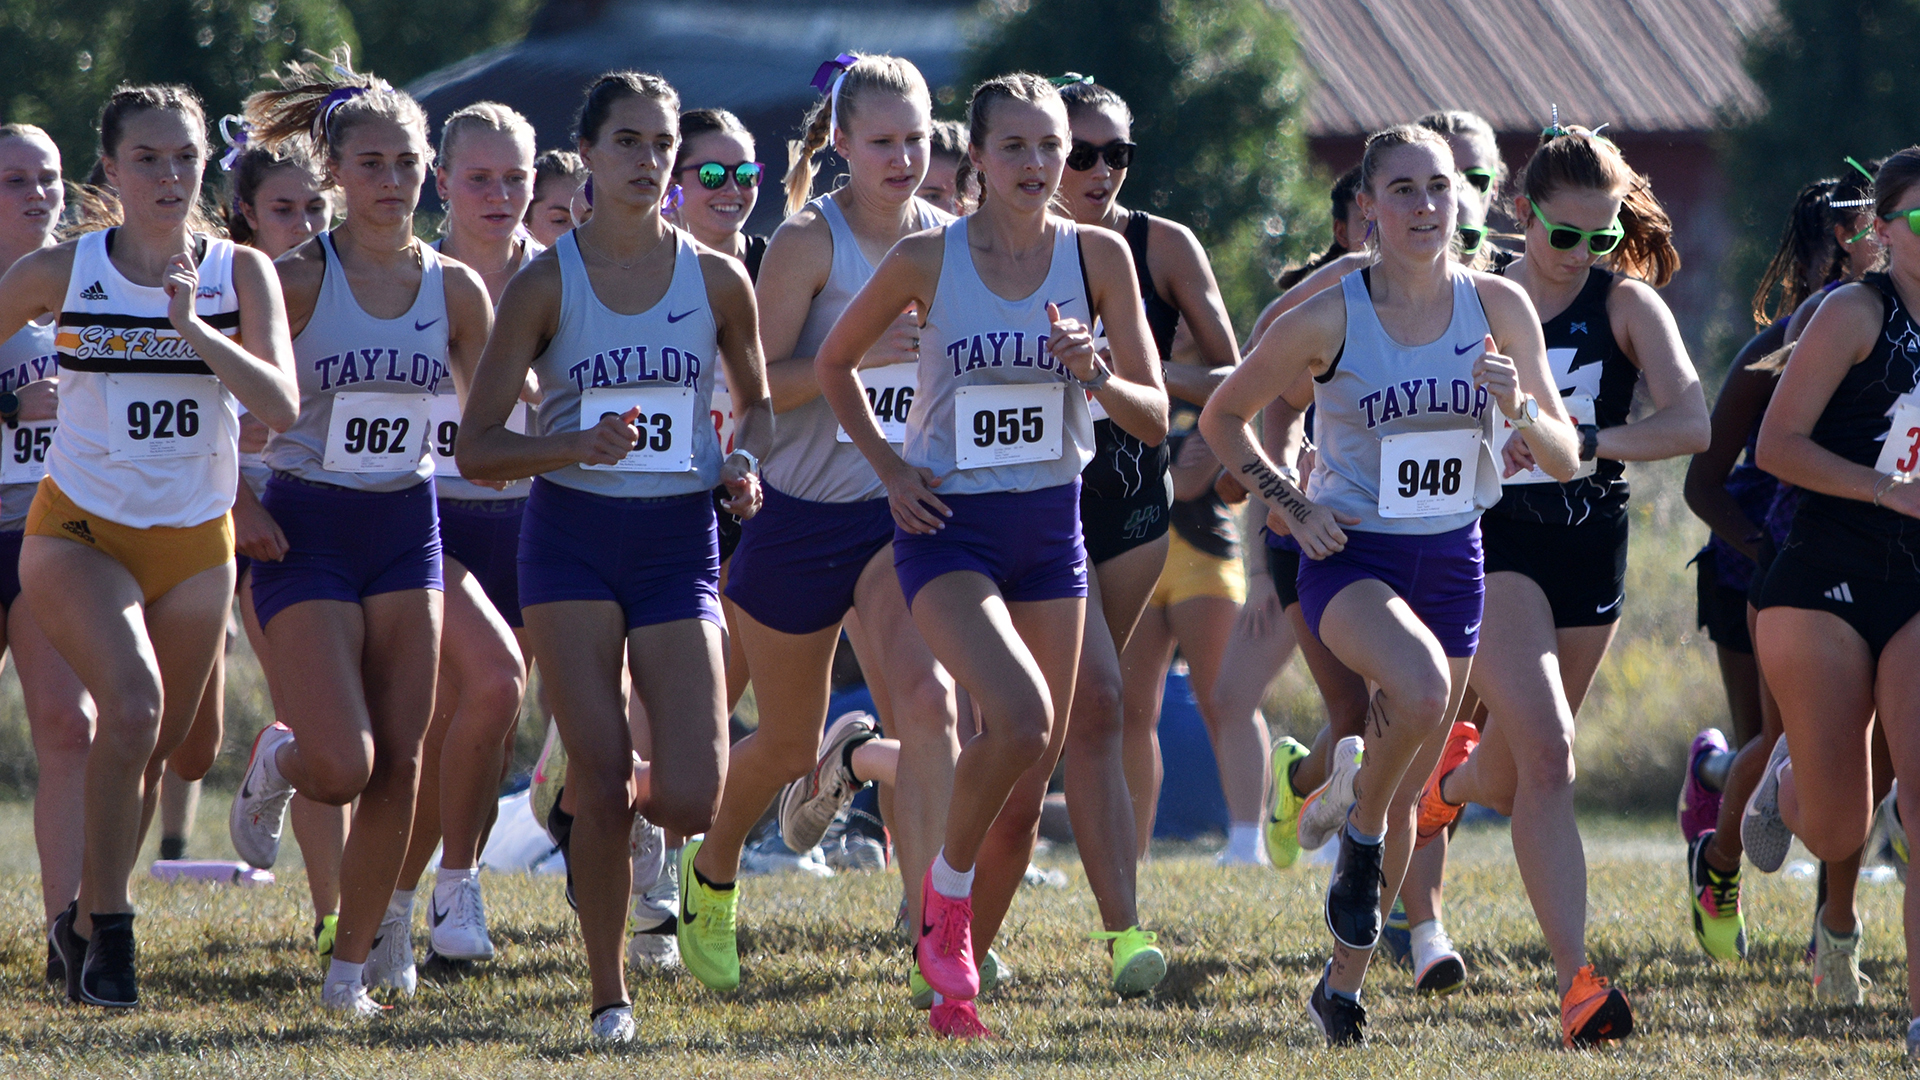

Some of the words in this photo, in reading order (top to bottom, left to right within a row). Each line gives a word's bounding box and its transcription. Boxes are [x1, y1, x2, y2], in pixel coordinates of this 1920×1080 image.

[80, 291, 108, 300] adidas
[75, 325, 115, 360] St.
[314, 348, 443, 396] TAYLOR
[568, 345, 701, 394] TAYLOR
[127, 398, 199, 440] 926
[1358, 377, 1489, 430] TAYLOR
[13, 427, 57, 464] 95
[344, 417, 410, 454] 962
[599, 411, 672, 452] 63
[973, 406, 1044, 447] 955
[1242, 454, 1311, 524] mindful
[1398, 458, 1463, 498] 948
[62, 522, 96, 543] adidas
